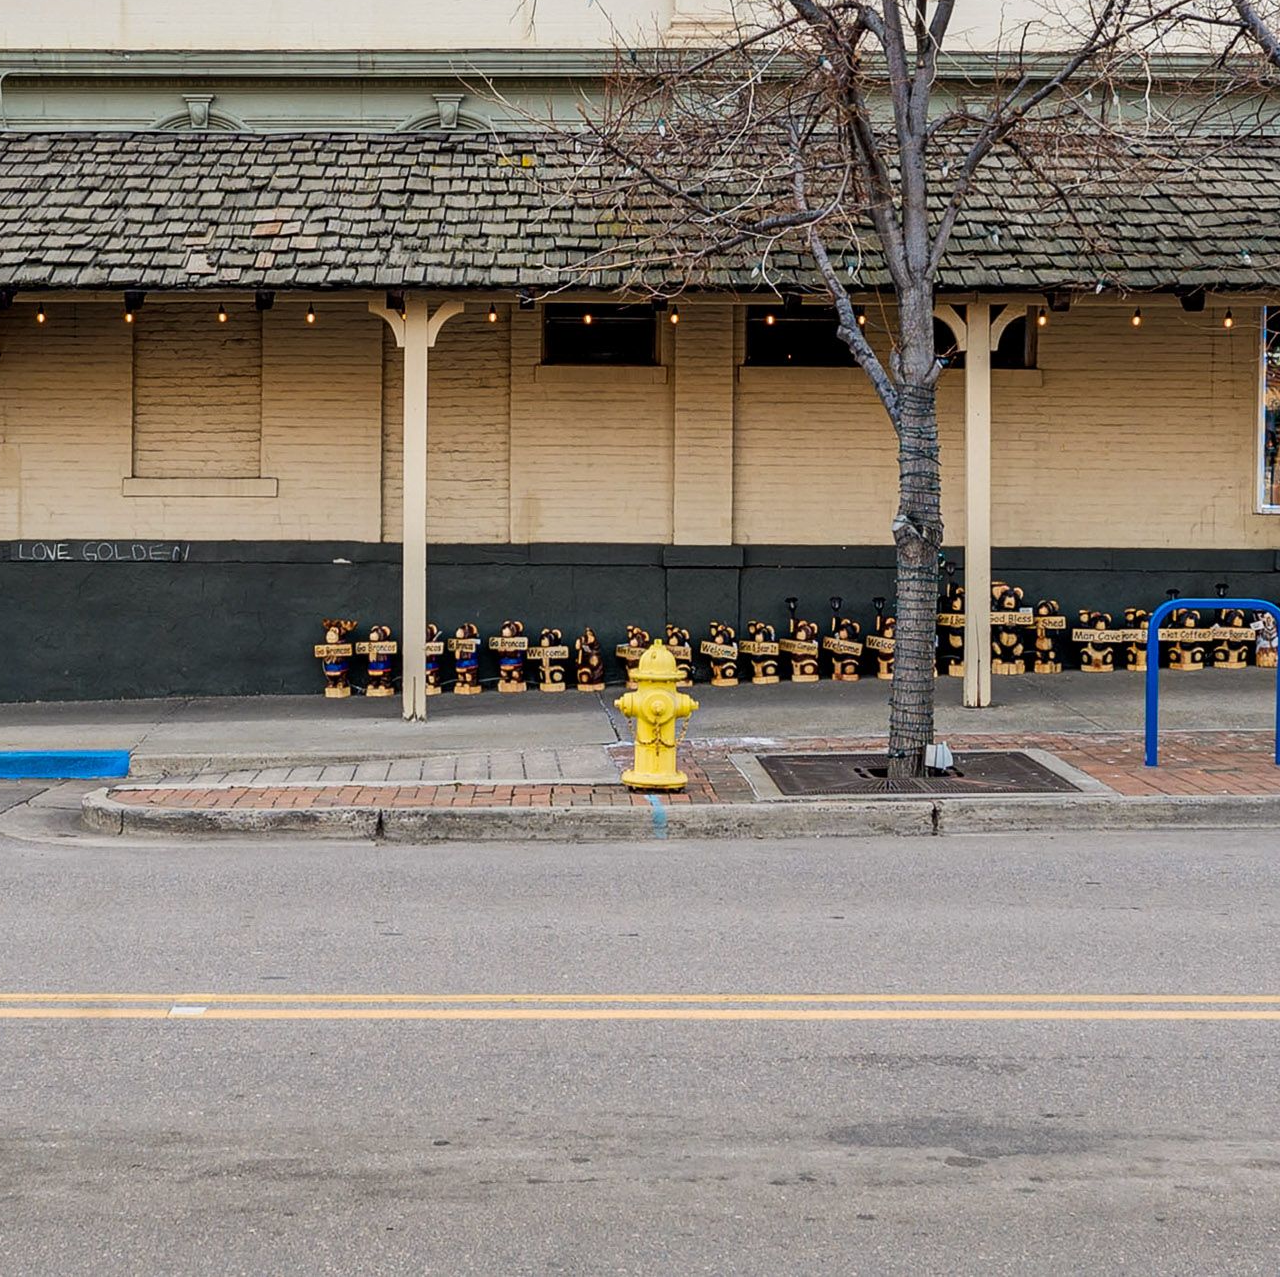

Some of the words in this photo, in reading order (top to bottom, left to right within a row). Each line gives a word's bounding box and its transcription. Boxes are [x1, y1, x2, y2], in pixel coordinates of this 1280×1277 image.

[19, 542, 73, 561] LOVE
[83, 542, 190, 562] GOLDEN
[1008, 613, 1032, 624] Bless
[1041, 618, 1064, 628] Shed
[1074, 631, 1095, 641] Man
[1097, 631, 1121, 641] Cave
[1180, 630, 1212, 640] Coffee?
[356, 643, 366, 653] Go
[368, 642, 396, 653] Broncos
[490, 638, 499, 648] Go
[501, 639, 526, 649] Broncos
[823, 639, 861, 655] Welcome
[867, 637, 895, 649] Welco
[316, 646, 324, 656] Go
[326, 645, 351, 656] Broncos
[527, 648, 568, 658] Welcome
[702, 642, 736, 658] Welcome
